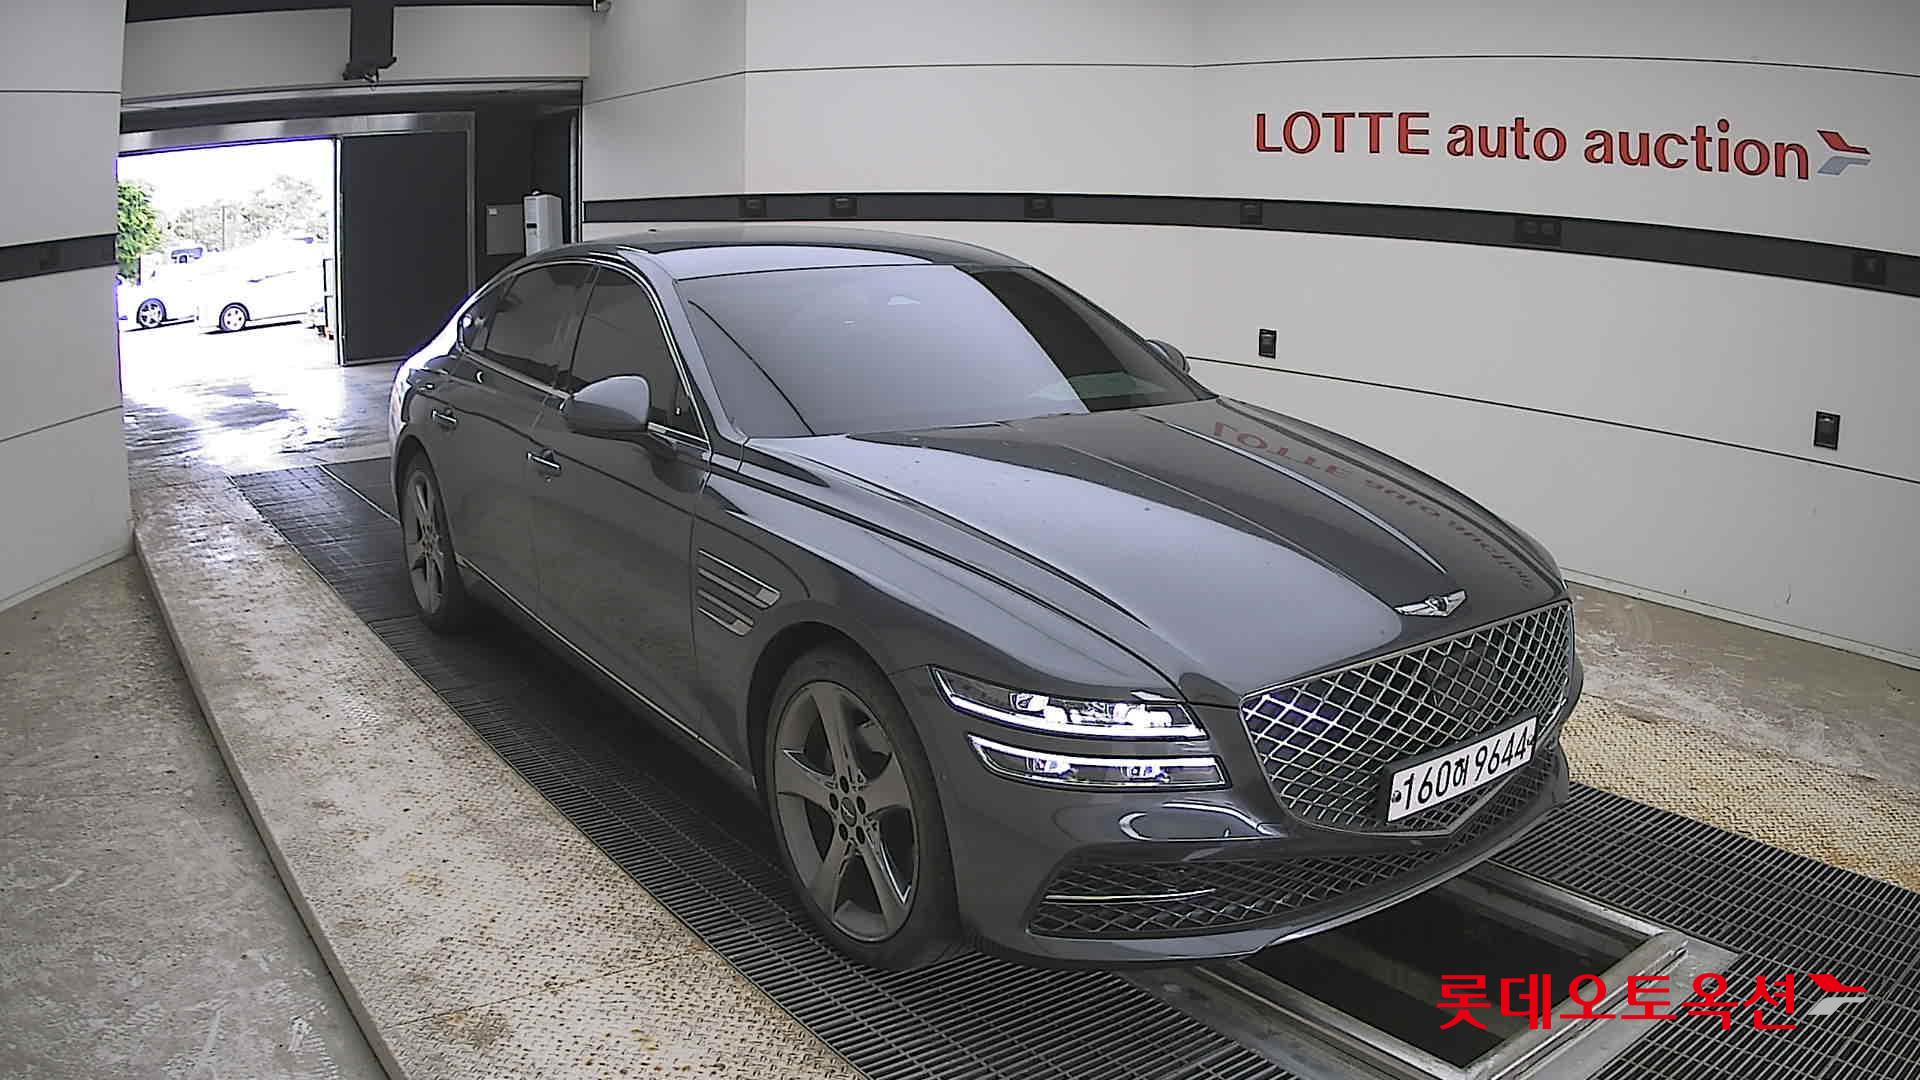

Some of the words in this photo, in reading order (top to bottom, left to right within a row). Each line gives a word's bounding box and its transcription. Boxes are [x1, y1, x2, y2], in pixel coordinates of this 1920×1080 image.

[1255, 111, 1430, 156] LOTTE
[1446, 116, 1568, 162] auto
[1583, 118, 1810, 181] auction
